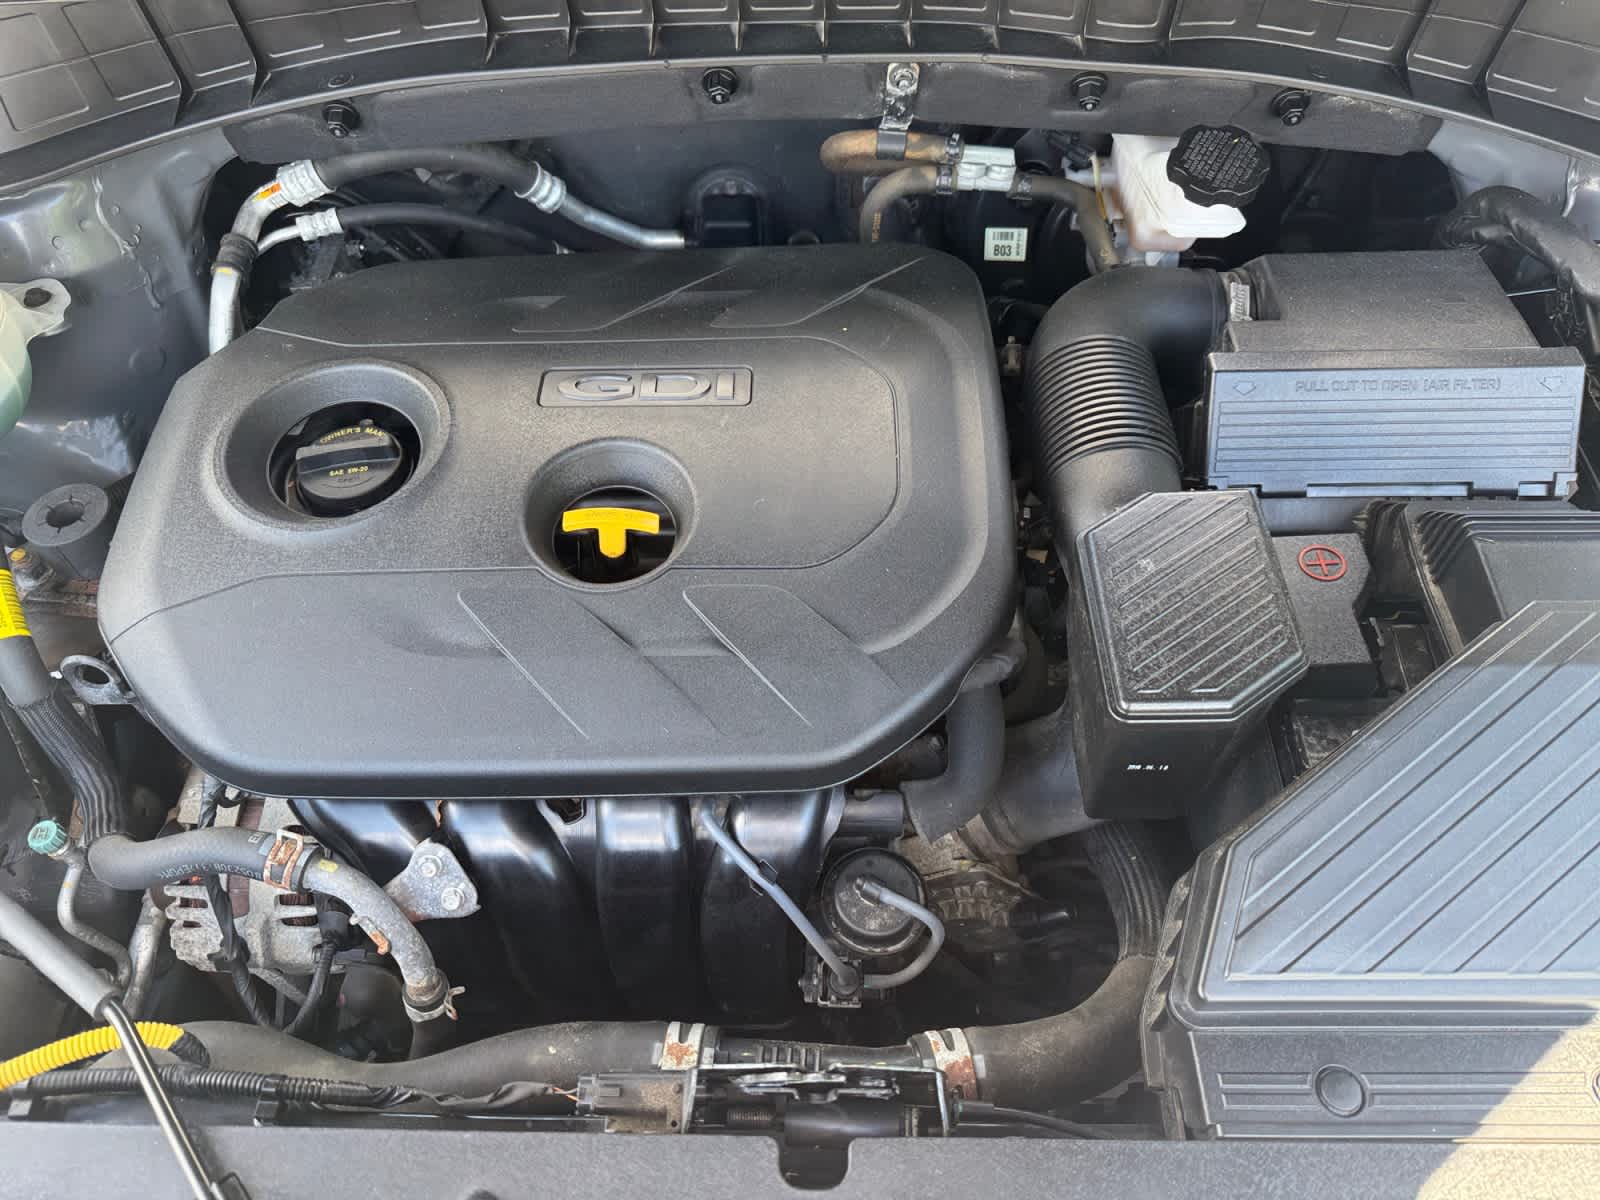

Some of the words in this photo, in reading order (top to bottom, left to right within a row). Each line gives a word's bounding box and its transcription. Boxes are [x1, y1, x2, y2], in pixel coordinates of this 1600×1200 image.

[993, 244, 1012, 257] B03
[558, 373, 735, 401] GDI
[1296, 380, 1329, 393] PULL
[1331, 379, 1359, 392] OUT
[1361, 379, 1379, 392] TO
[1381, 379, 1418, 392] OPEN
[347, 466, 369, 474] 5W-20
